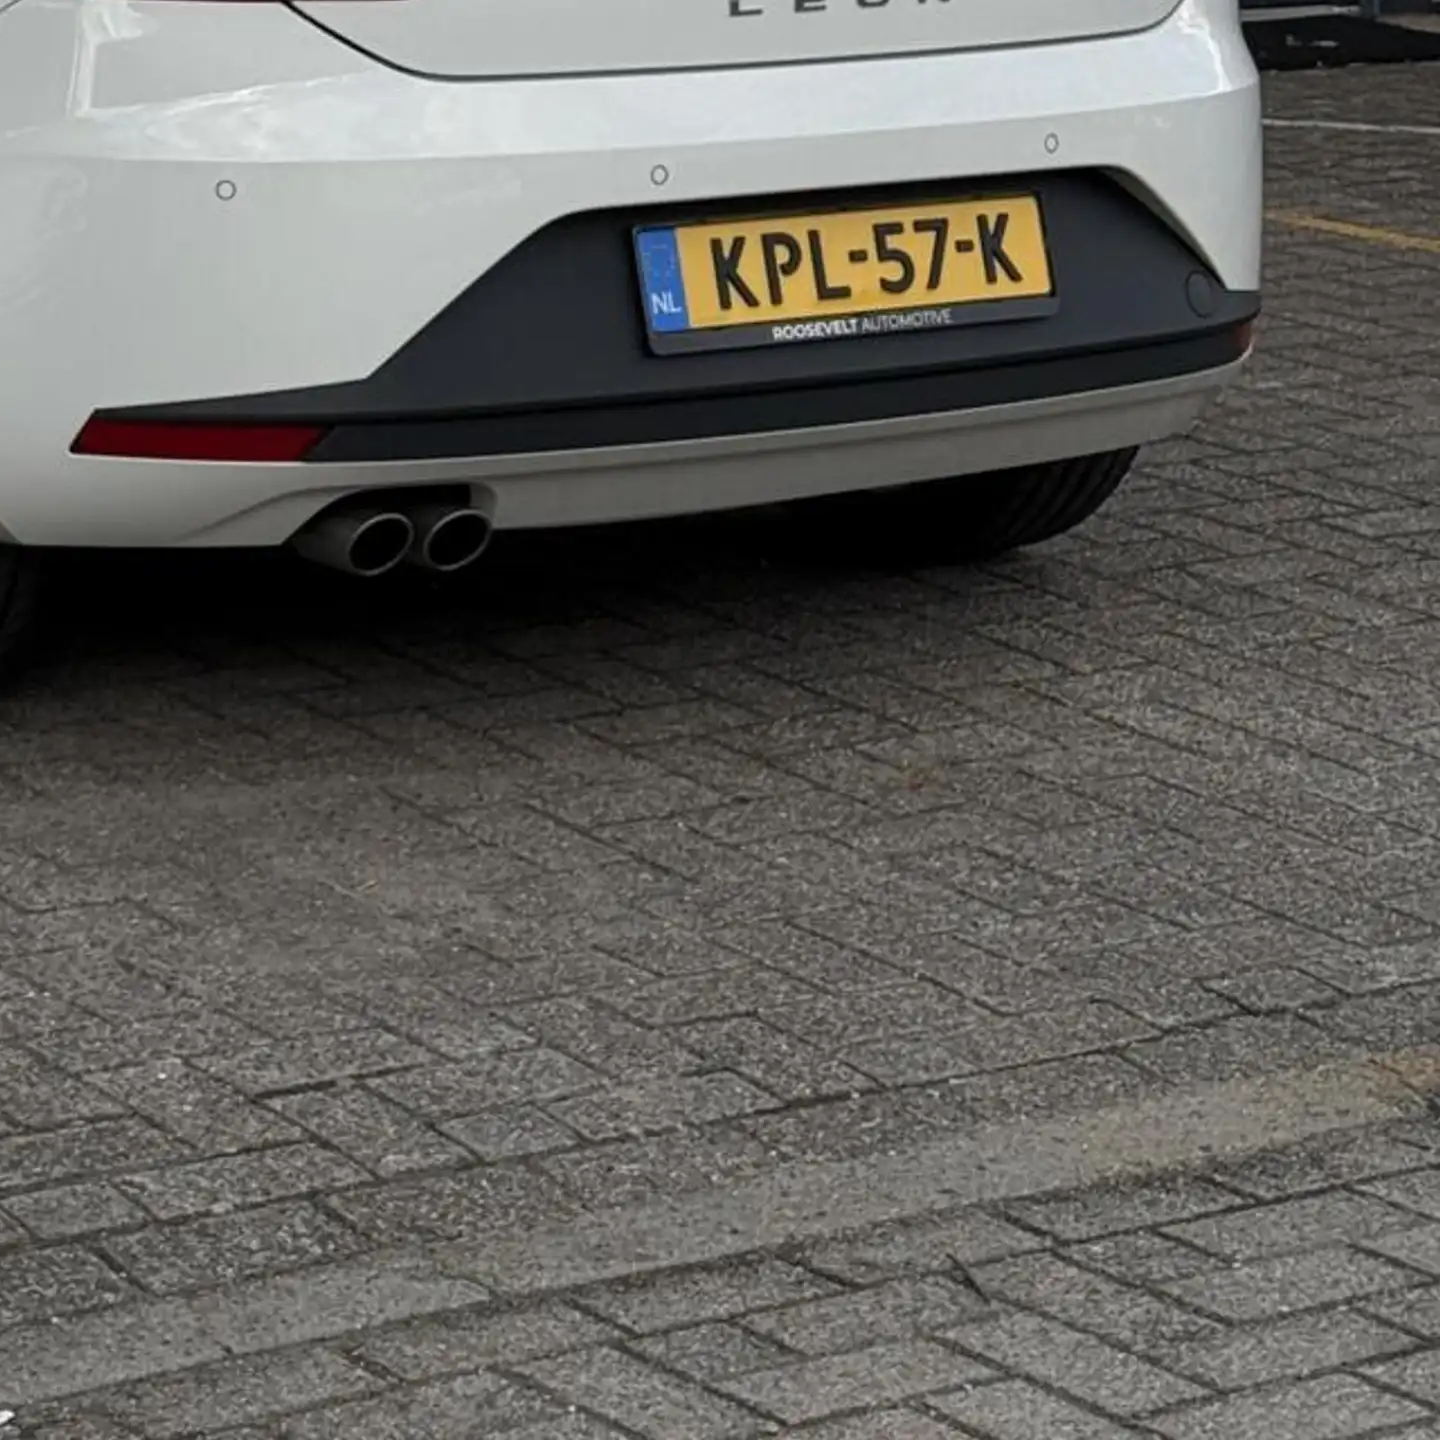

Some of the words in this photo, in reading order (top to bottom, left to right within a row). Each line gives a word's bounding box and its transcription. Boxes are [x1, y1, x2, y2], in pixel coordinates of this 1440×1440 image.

[710, 212, 1023, 311] KPL-57-K
[651, 293, 682, 316] NL
[772, 318, 858, 342] ROOSEVELT
[860, 309, 953, 335] AUTOMOTIVE
